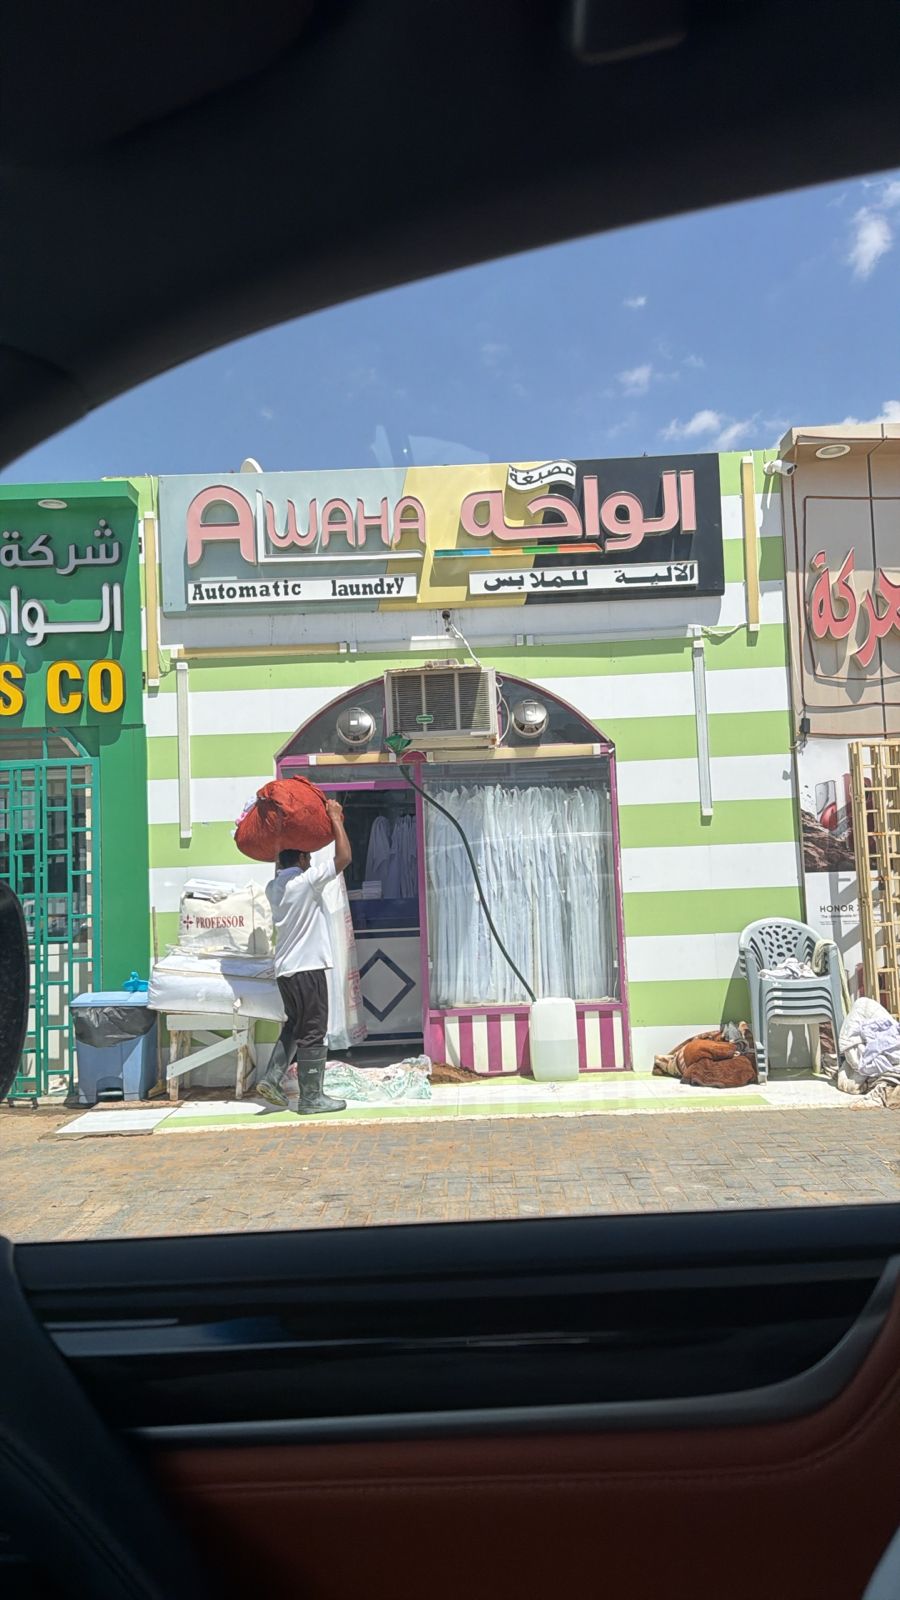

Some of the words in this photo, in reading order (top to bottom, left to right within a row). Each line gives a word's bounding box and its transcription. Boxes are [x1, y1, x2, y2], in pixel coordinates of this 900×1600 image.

[509, 466, 574, 485] مصبغة
[0, 519, 120, 574] شركة
[192, 579, 301, 600] Automatic
[483, 570, 589, 591] للملابس
[46, 660, 124, 714] CO
[819, 904, 854, 913] HONOR
[196, 915, 245, 929] PROFESSOR
